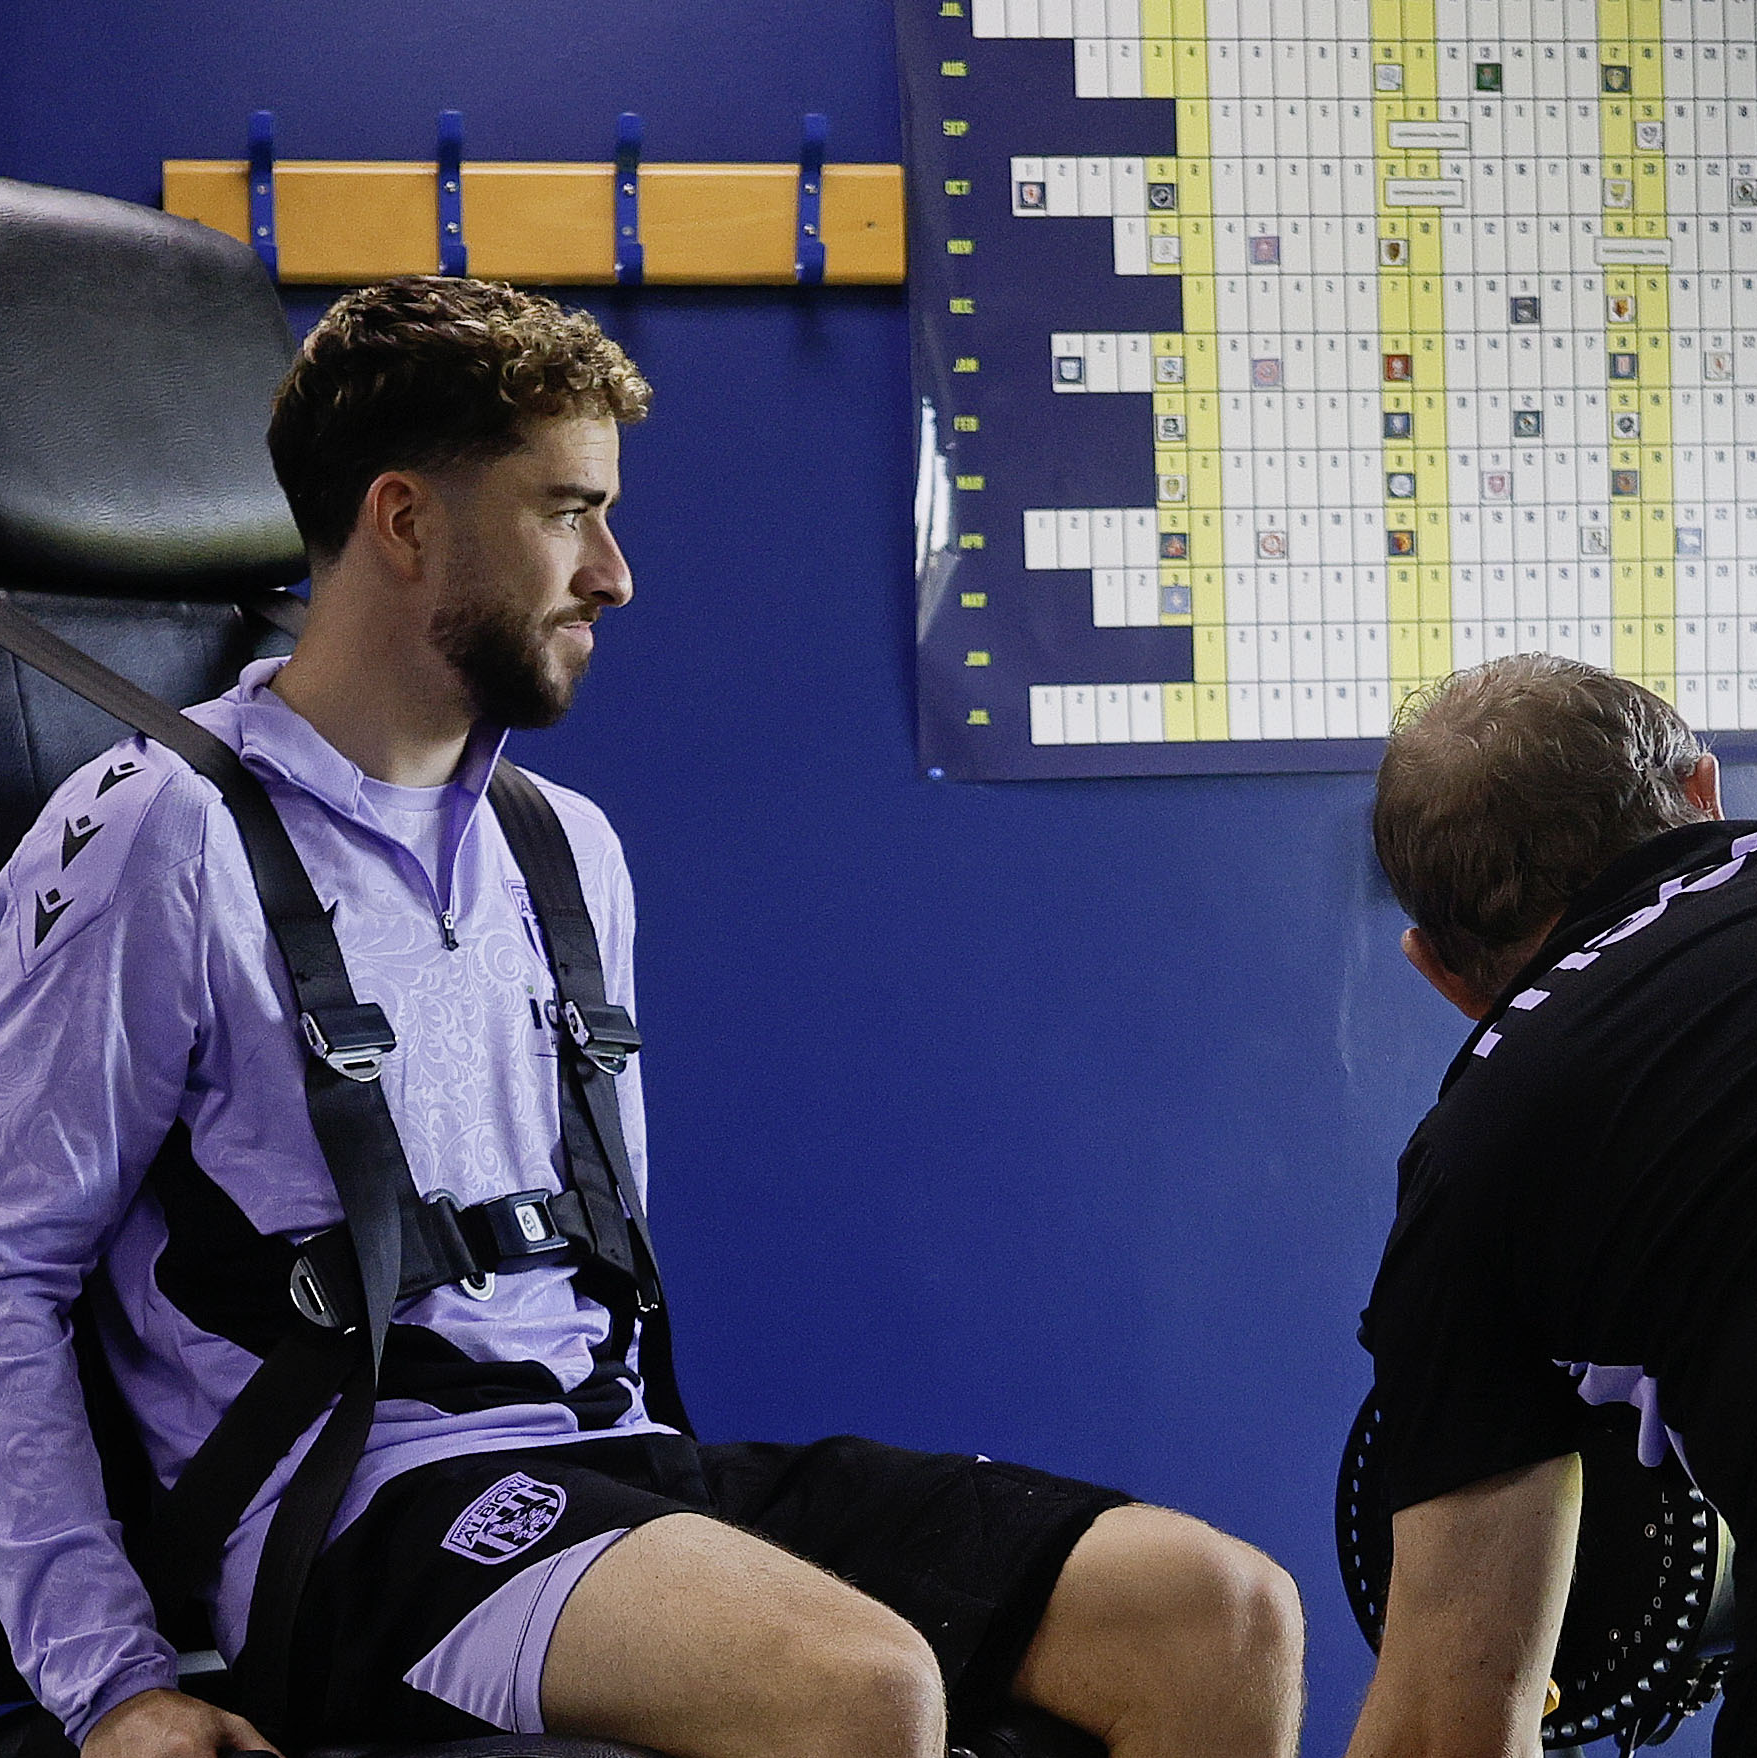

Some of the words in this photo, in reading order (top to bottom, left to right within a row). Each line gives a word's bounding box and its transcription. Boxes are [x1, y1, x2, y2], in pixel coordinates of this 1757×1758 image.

[944, 179, 971, 195] OCT
[1661, 1492, 1669, 1504] L
[464, 1478, 528, 1546] ALBION
[1664, 1513, 1674, 1525] M
[1664, 1535, 1673, 1547] N
[1659, 1576, 1666, 1589] P
[1644, 1614, 1652, 1627] R
[1621, 1647, 1629, 1659] T
[1607, 1659, 1616, 1671] U
